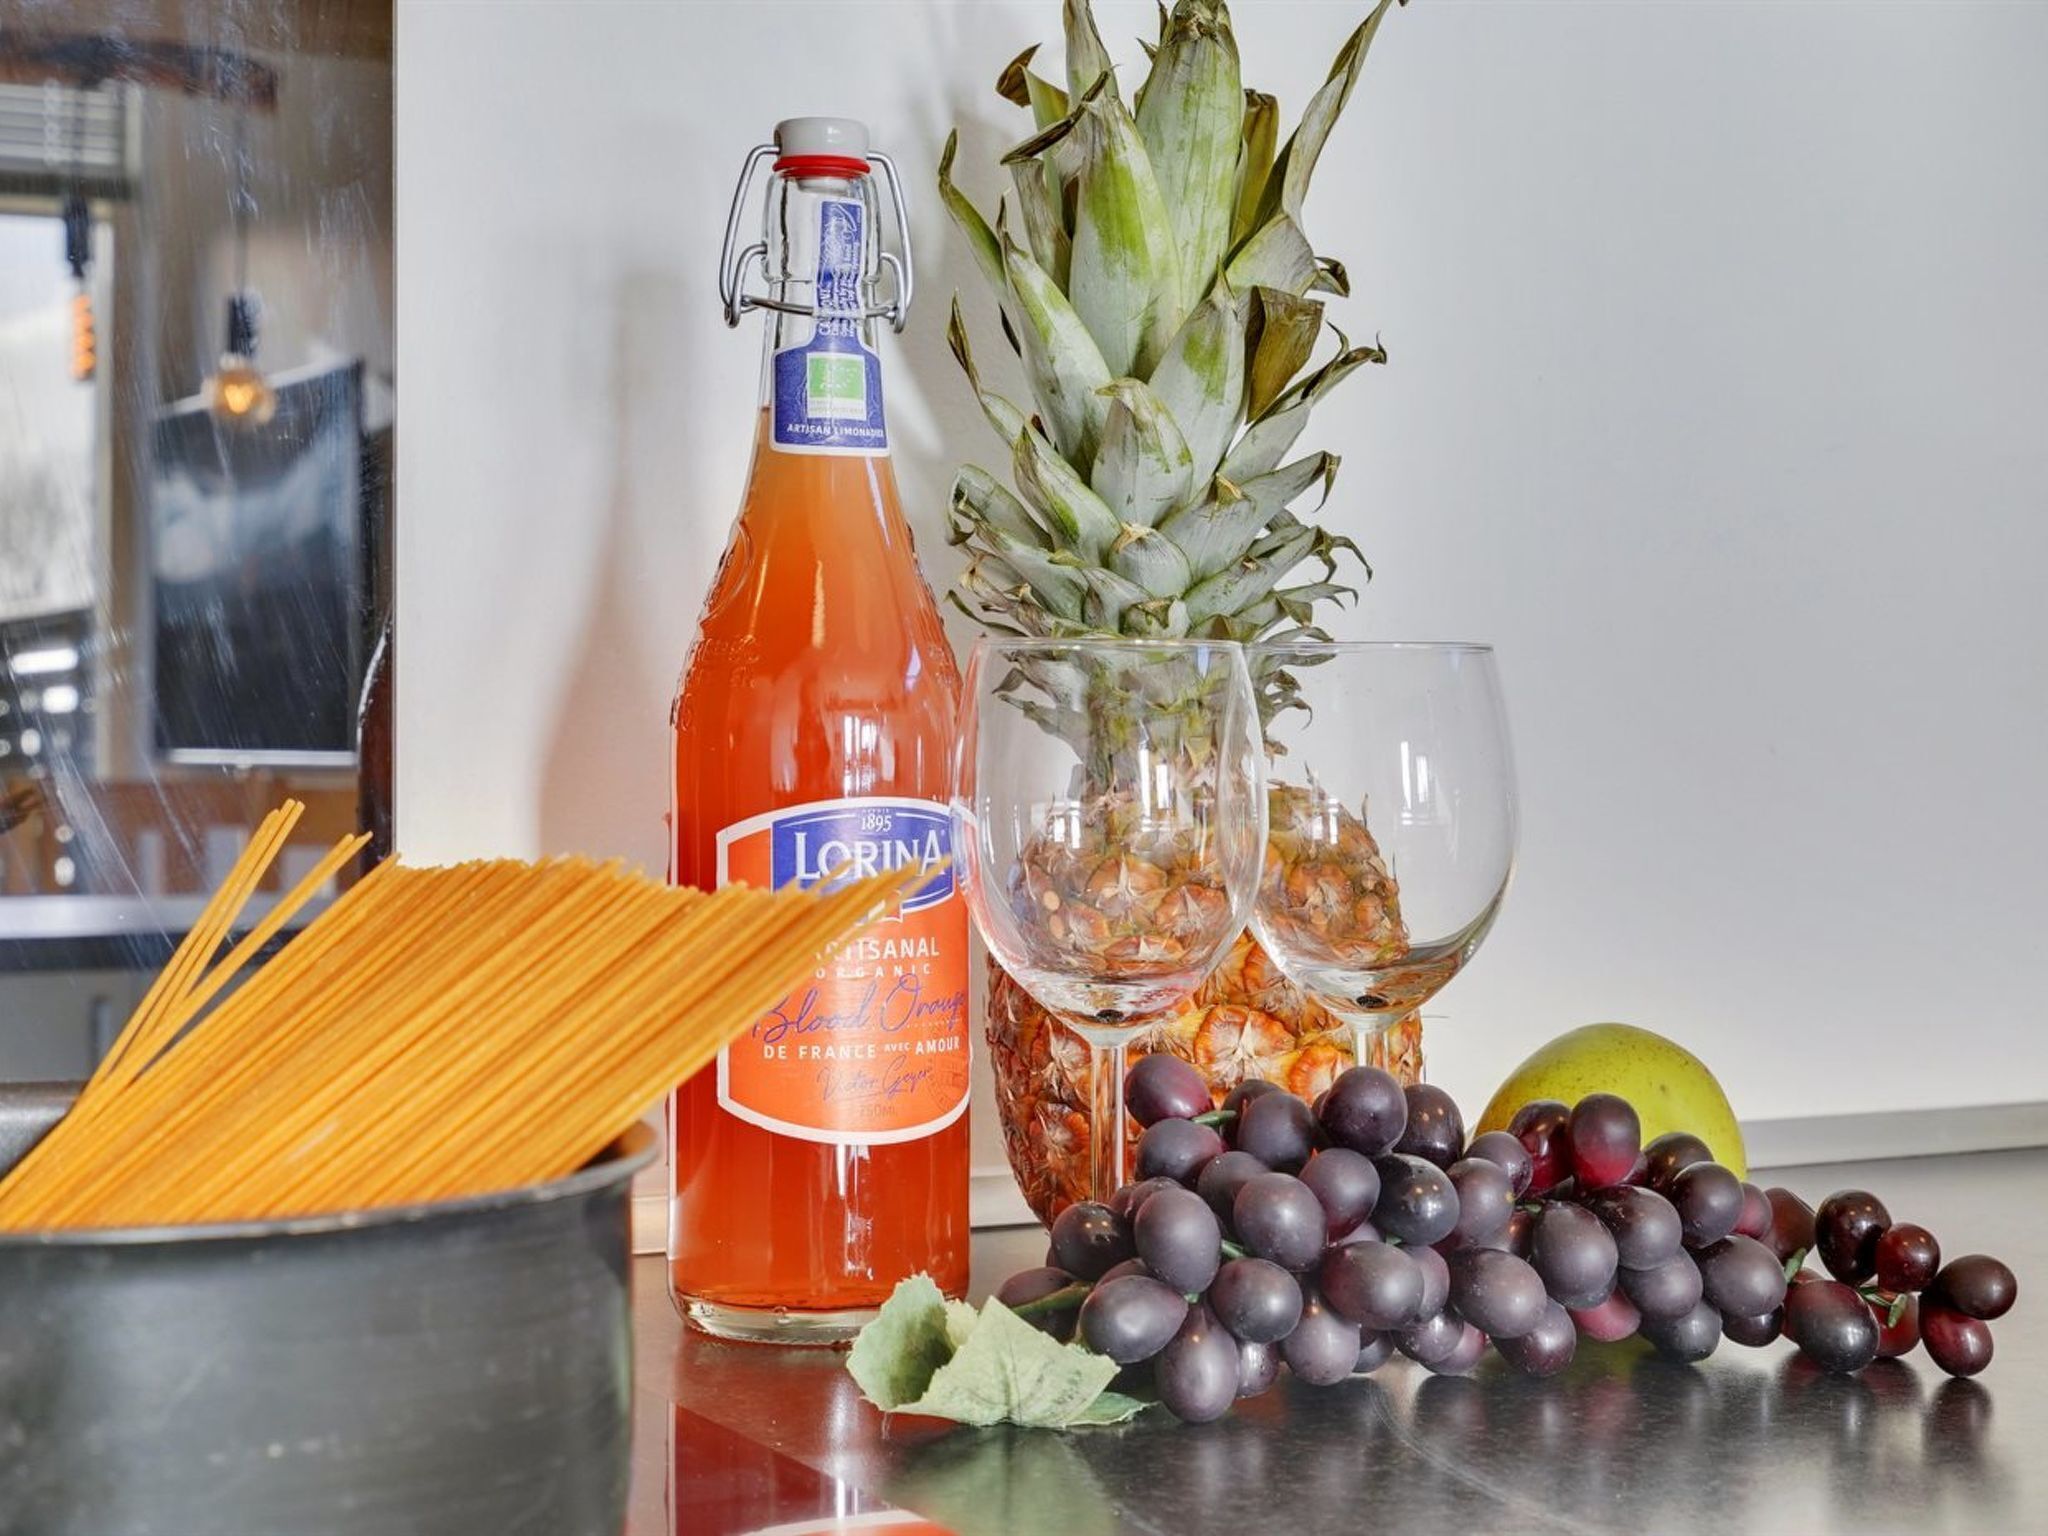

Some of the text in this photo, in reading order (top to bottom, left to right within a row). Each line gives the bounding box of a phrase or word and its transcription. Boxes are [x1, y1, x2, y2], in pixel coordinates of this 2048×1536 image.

[787, 423, 831, 434] ARTISAN
[862, 813, 892, 832] 1895
[794, 829, 946, 880] LORINA
[815, 936, 940, 961] TISANAL
[815, 963, 931, 979] ORGANIC
[752, 980, 877, 1044] Blood
[763, 1036, 960, 1060] DE FRANCE AVEC AMOUR
